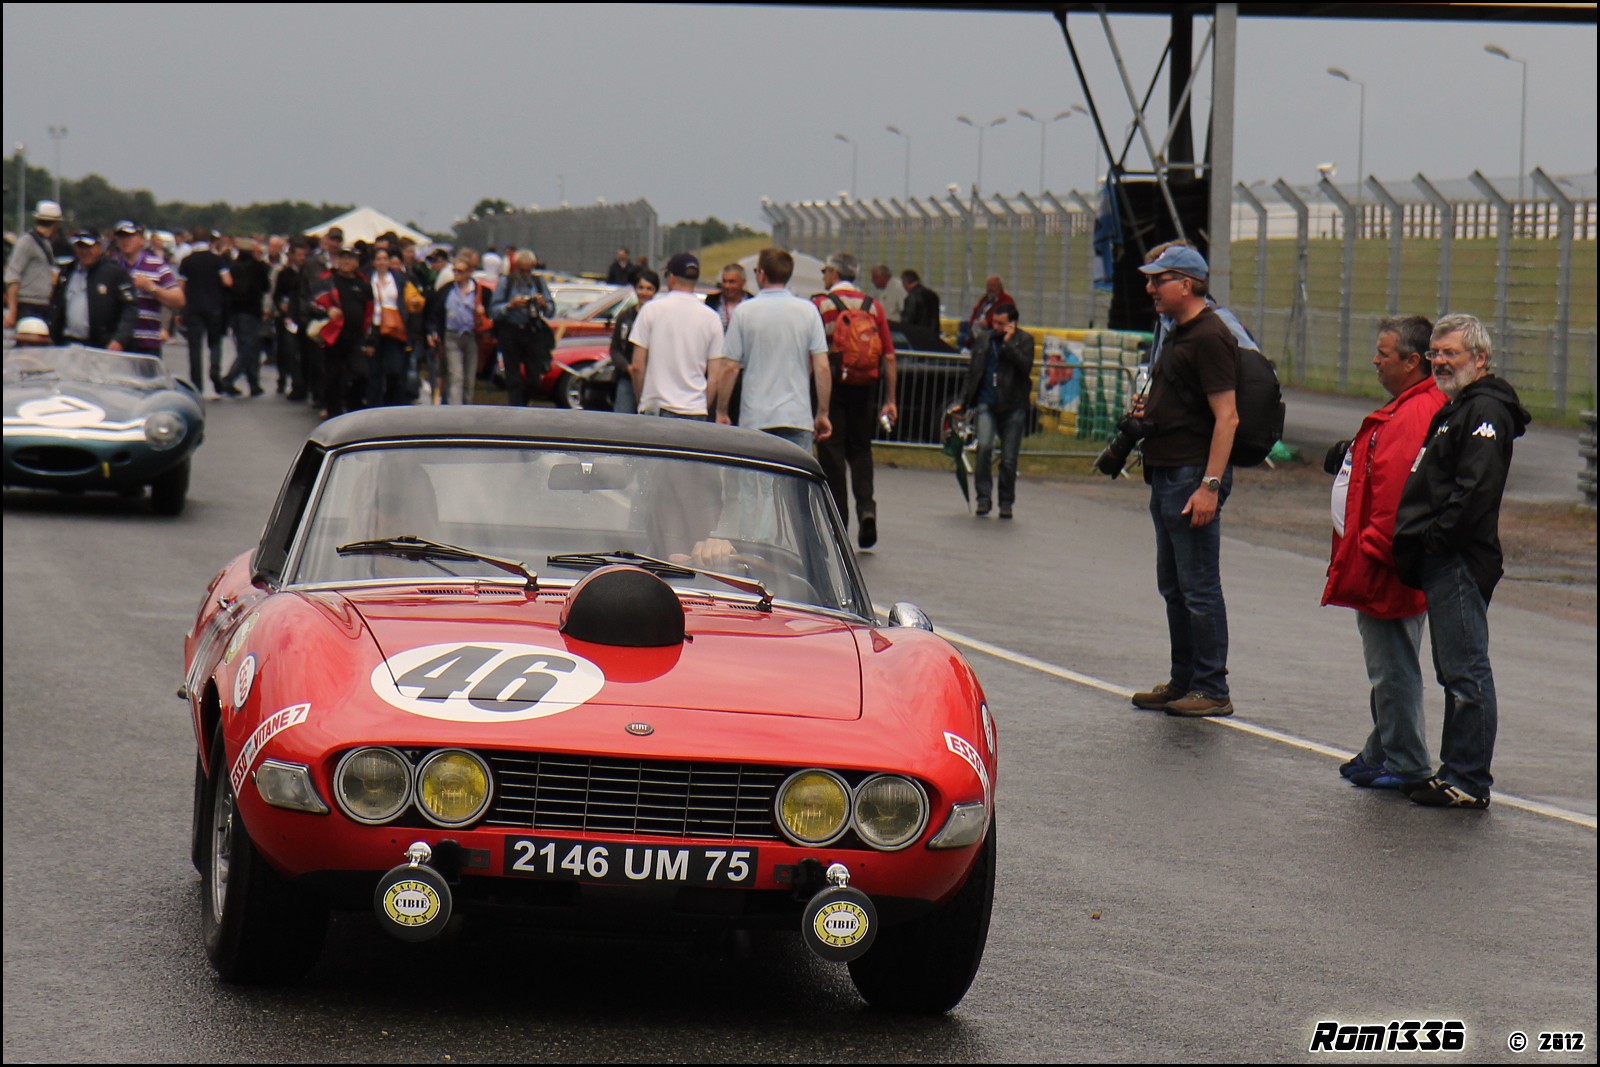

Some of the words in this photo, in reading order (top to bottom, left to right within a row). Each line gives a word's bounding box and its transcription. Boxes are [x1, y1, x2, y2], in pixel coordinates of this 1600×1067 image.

[396, 645, 577, 712] 46
[254, 710, 290, 751] VITANE
[294, 706, 306, 723] 7
[512, 840, 609, 878] 2146
[624, 848, 690, 881] UM
[704, 850, 750, 882] 75
[392, 883, 434, 897] RACING
[822, 904, 863, 917] RACING
[396, 914, 428, 923] TEAM
[825, 935, 857, 944] TEAM
